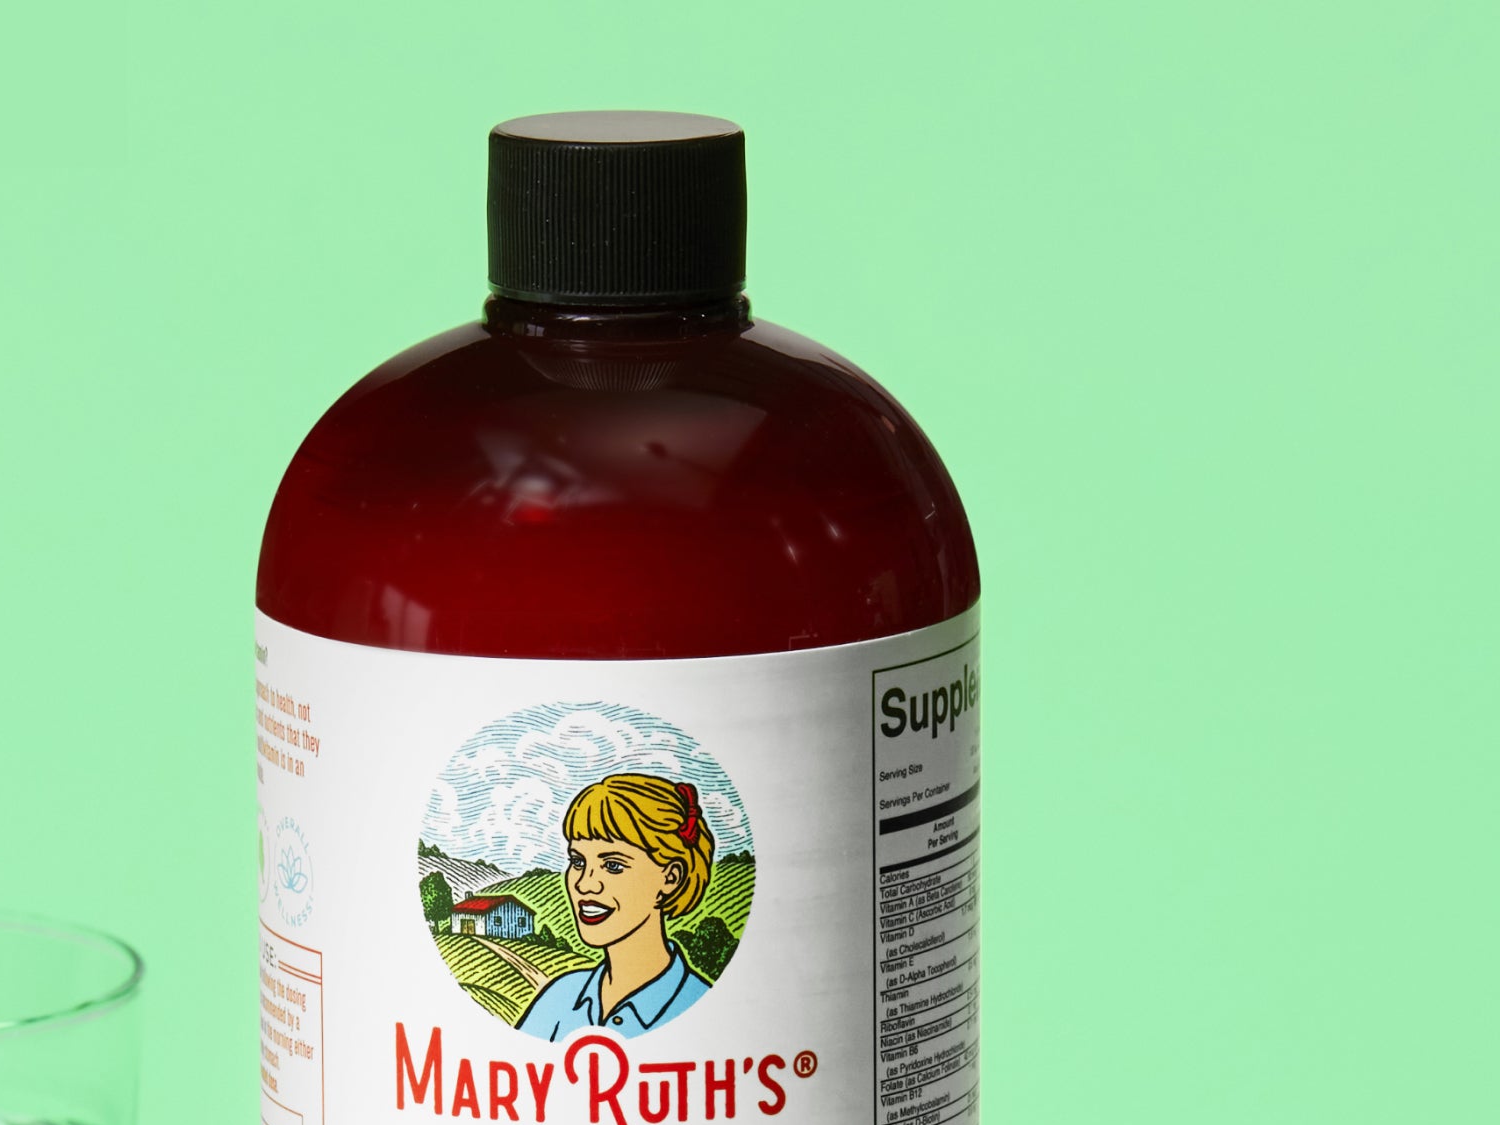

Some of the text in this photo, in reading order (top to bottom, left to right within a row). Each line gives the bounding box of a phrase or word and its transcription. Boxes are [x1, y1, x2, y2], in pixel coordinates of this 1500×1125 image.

[298, 703, 310, 722] not
[287, 723, 300, 747] that
[303, 730, 320, 757] they
[295, 759, 305, 777] an
[879, 762, 923, 782] Serving Size
[879, 782, 950, 810] Servings Per Container
[933, 816, 955, 833] Amount
[928, 836, 938, 849] Per
[880, 871, 909, 884] Calories
[881, 889, 898, 899] Total
[881, 901, 907, 914] Vitamin
[908, 898, 914, 906] A
[916, 896, 925, 906] (as
[881, 916, 907, 929] Vitamin
[909, 912, 915, 922] C
[881, 927, 914, 944] Vitamin D
[886, 947, 897, 959] (as
[881, 956, 914, 973] Vitamin E
[886, 978, 897, 989] (as
[900, 970, 926, 983] D-Alpha
[881, 990, 909, 1003] Thiamin
[887, 1007, 898, 1018] (as
[296, 1016, 300, 1031] a
[881, 1017, 915, 1033] Riboflavin
[881, 1035, 903, 1048] Niacin
[905, 1032, 915, 1044] (as
[295, 1039, 314, 1060] either
[881, 1045, 918, 1063] Vitamin B6
[395, 1021, 555, 1123] MARY
[887, 1067, 898, 1078] (as
[881, 1080, 903, 1092] Folate
[905, 1076, 916, 1088] (as
[881, 1088, 922, 1107] Vitamin B12
[887, 1111, 898, 1122] (as
